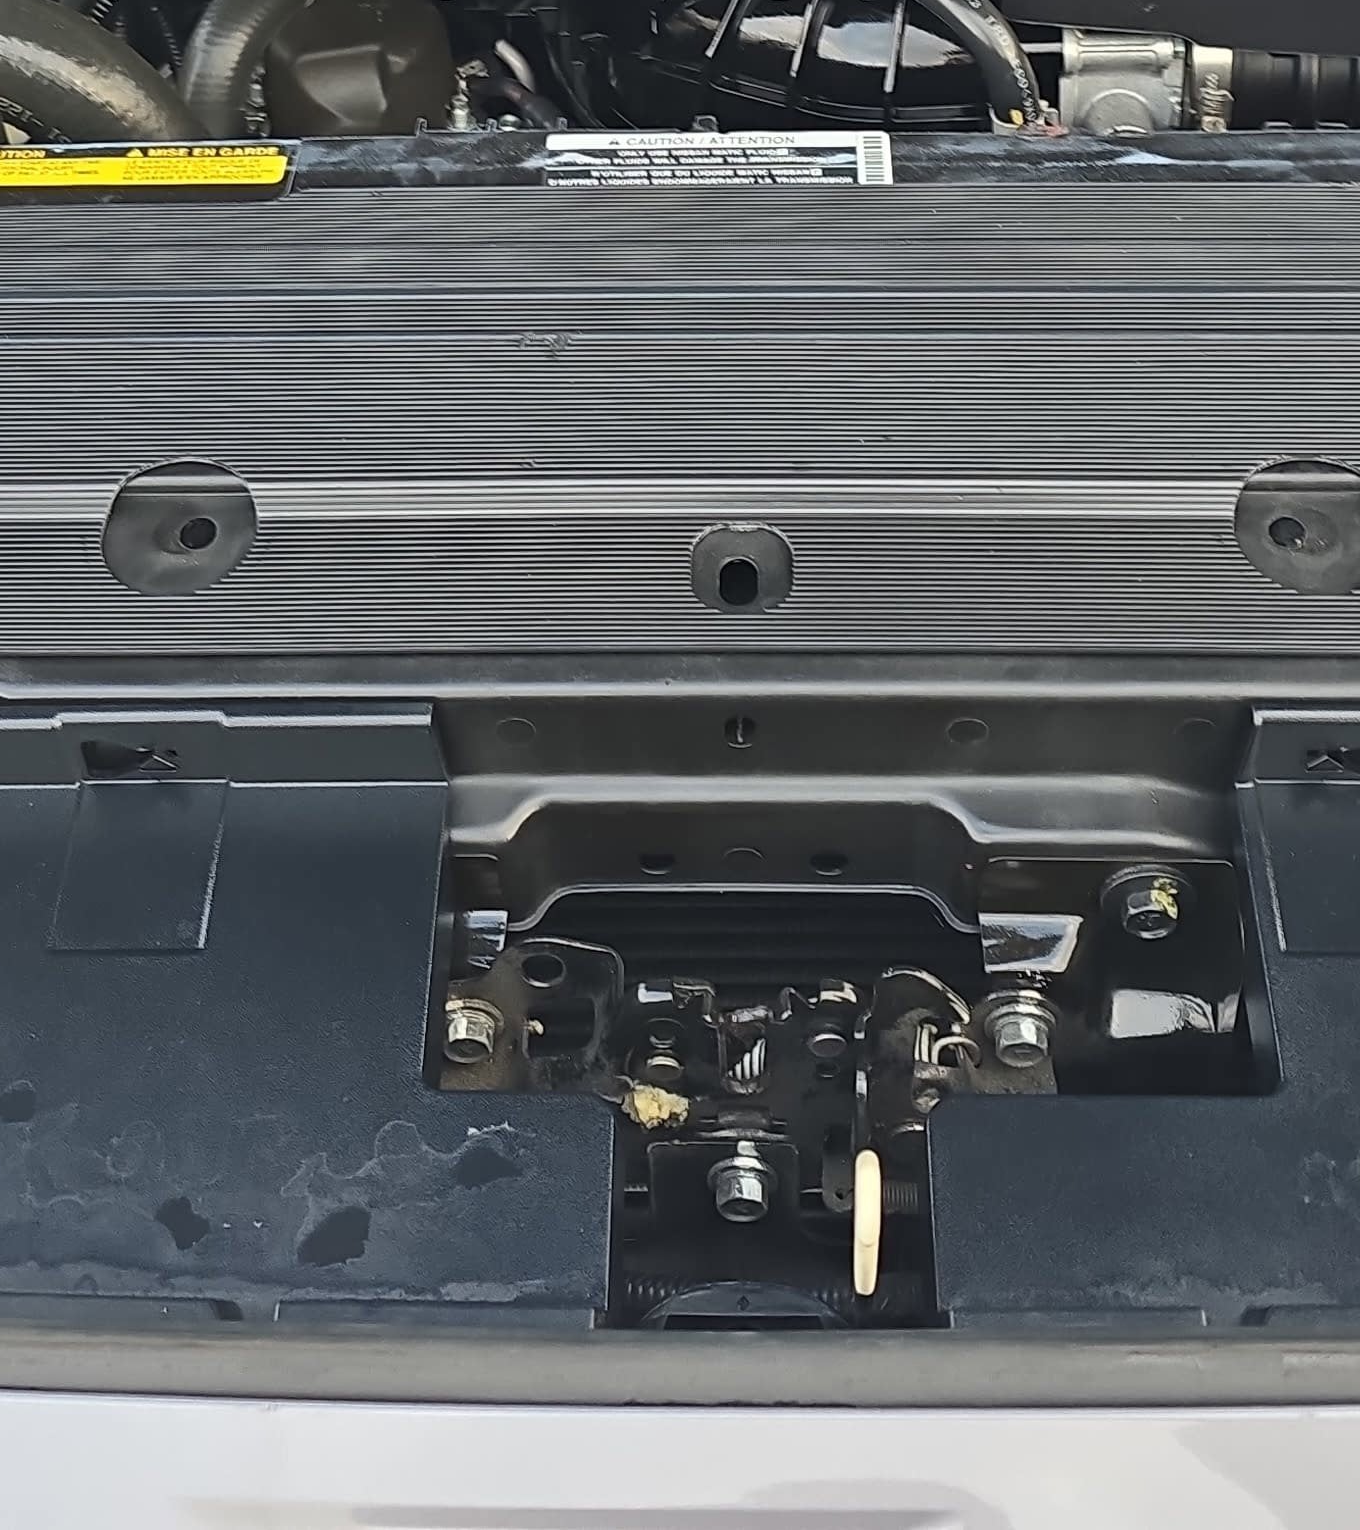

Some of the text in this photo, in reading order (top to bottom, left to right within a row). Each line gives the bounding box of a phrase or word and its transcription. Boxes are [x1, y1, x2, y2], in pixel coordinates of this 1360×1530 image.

[626, 136, 694, 146] CAUTION
[709, 136, 795, 145] ATTENTION
[147, 147, 280, 157] MISE EN GARDE
